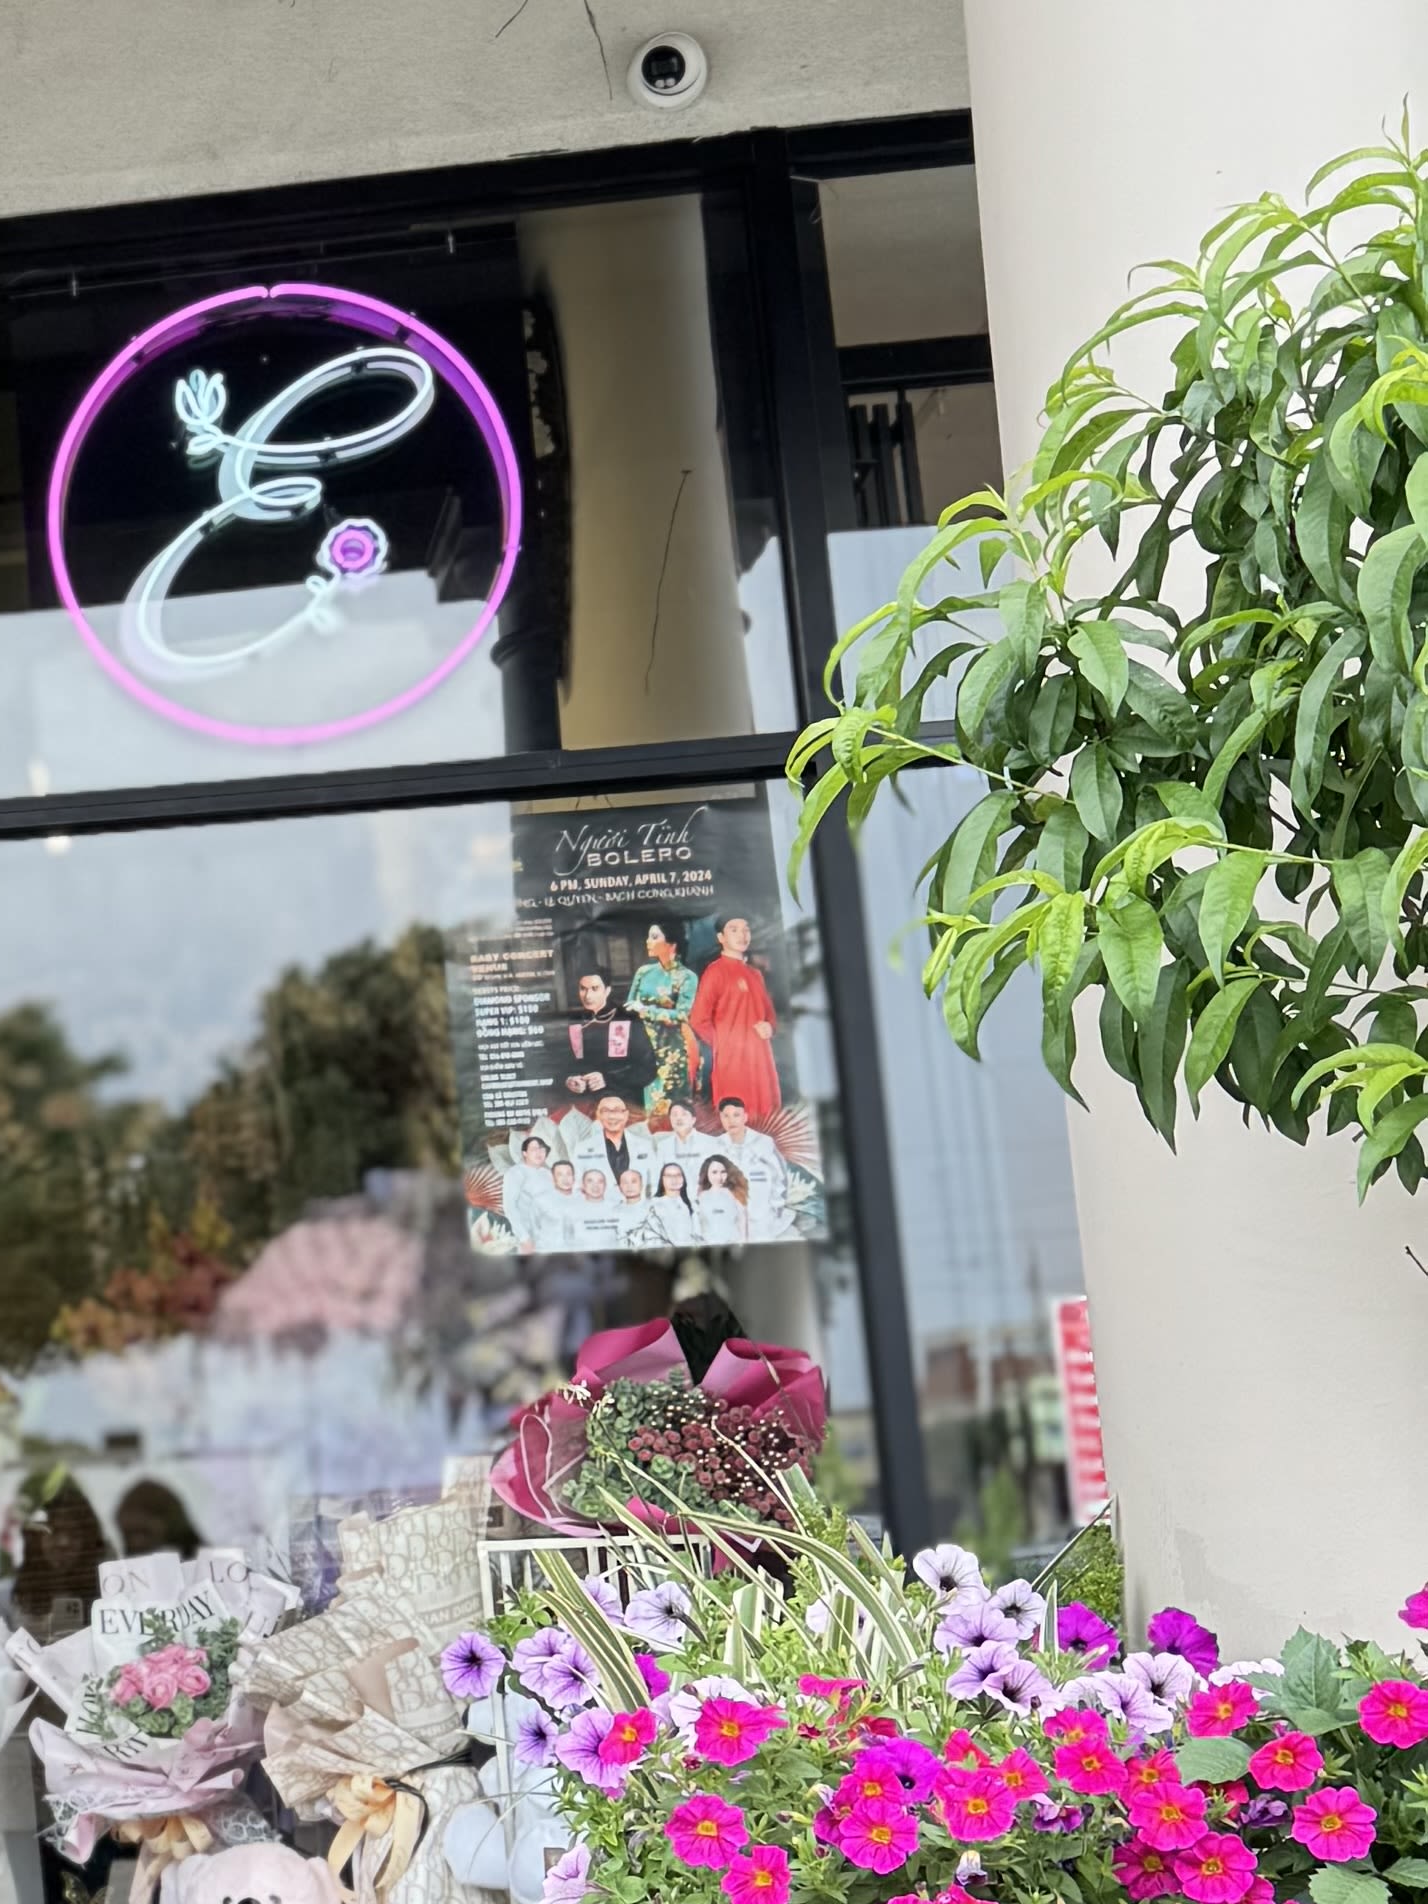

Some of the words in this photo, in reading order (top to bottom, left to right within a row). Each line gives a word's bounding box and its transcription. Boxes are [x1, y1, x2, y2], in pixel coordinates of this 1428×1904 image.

[586, 846, 693, 868] BOLERO
[550, 880, 559, 892] 6
[584, 874, 633, 889] SUNDAY,
[634, 872, 668, 886] APRIL
[670, 871, 681, 885] 7,
[683, 869, 713, 883] 2024
